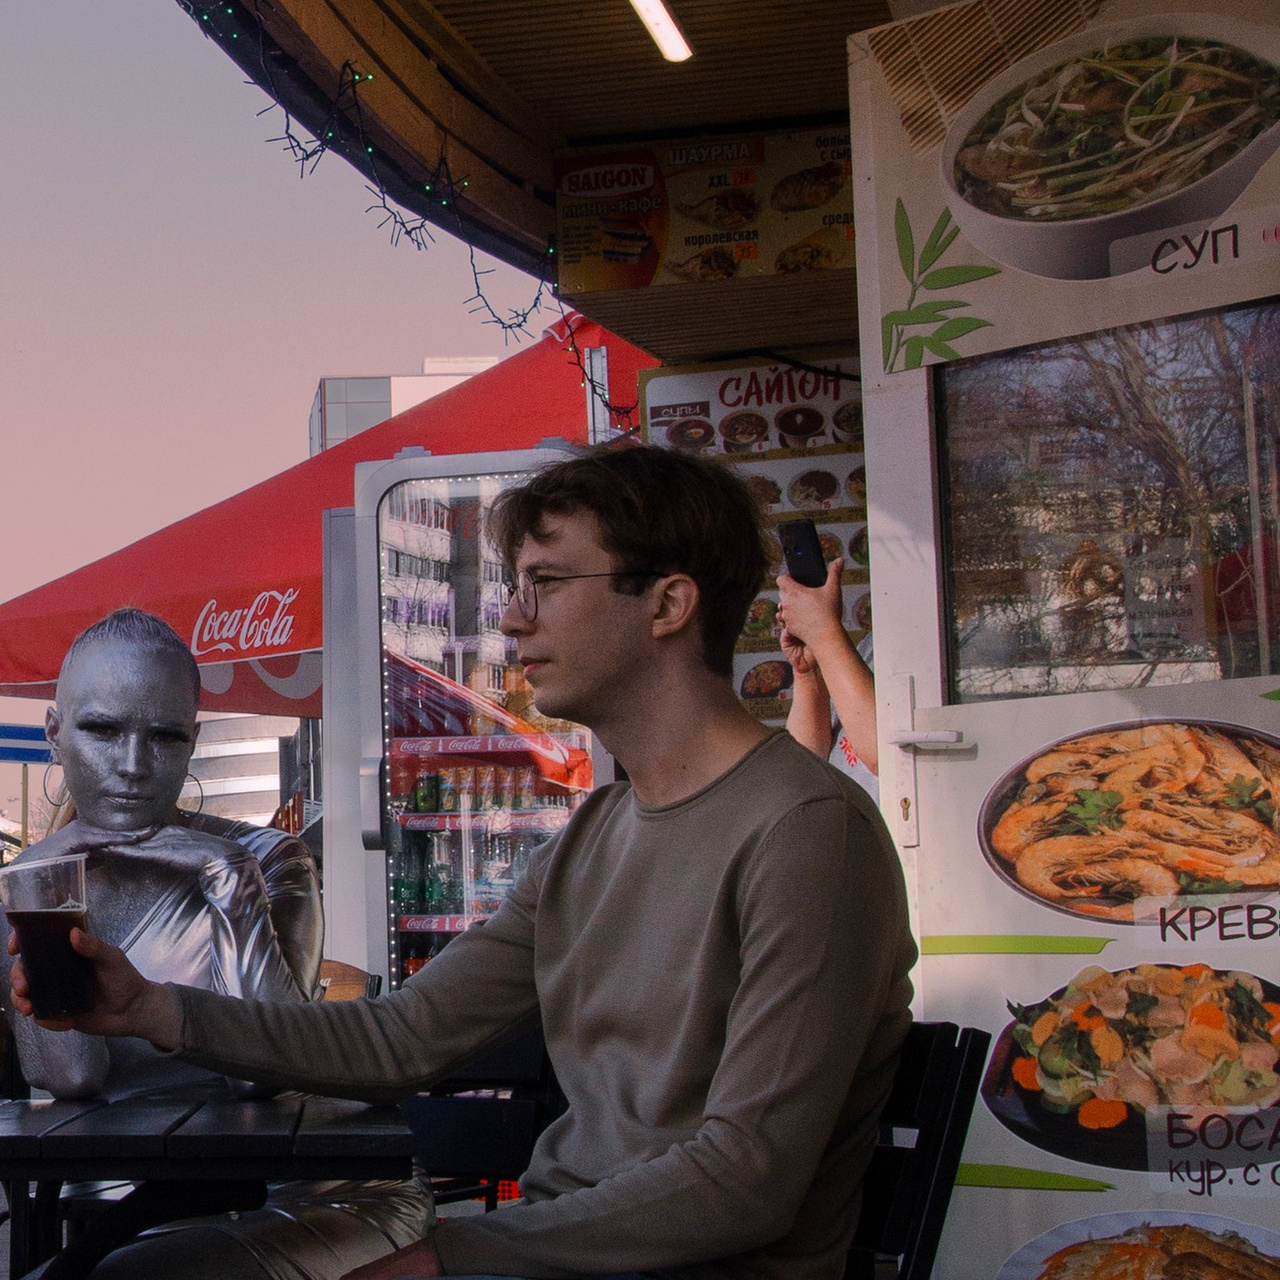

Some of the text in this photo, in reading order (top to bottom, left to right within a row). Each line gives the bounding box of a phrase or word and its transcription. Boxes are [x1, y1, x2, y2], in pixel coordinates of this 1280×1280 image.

[669, 143, 751, 165] ШАУРМА
[567, 167, 647, 193] SAIGON
[709, 173, 730, 188] XXL
[684, 229, 759, 248] королевская
[1151, 224, 1239, 274] СУП
[190, 586, 301, 656] Coca-Cola
[1160, 905, 1280, 942] КРЕВ
